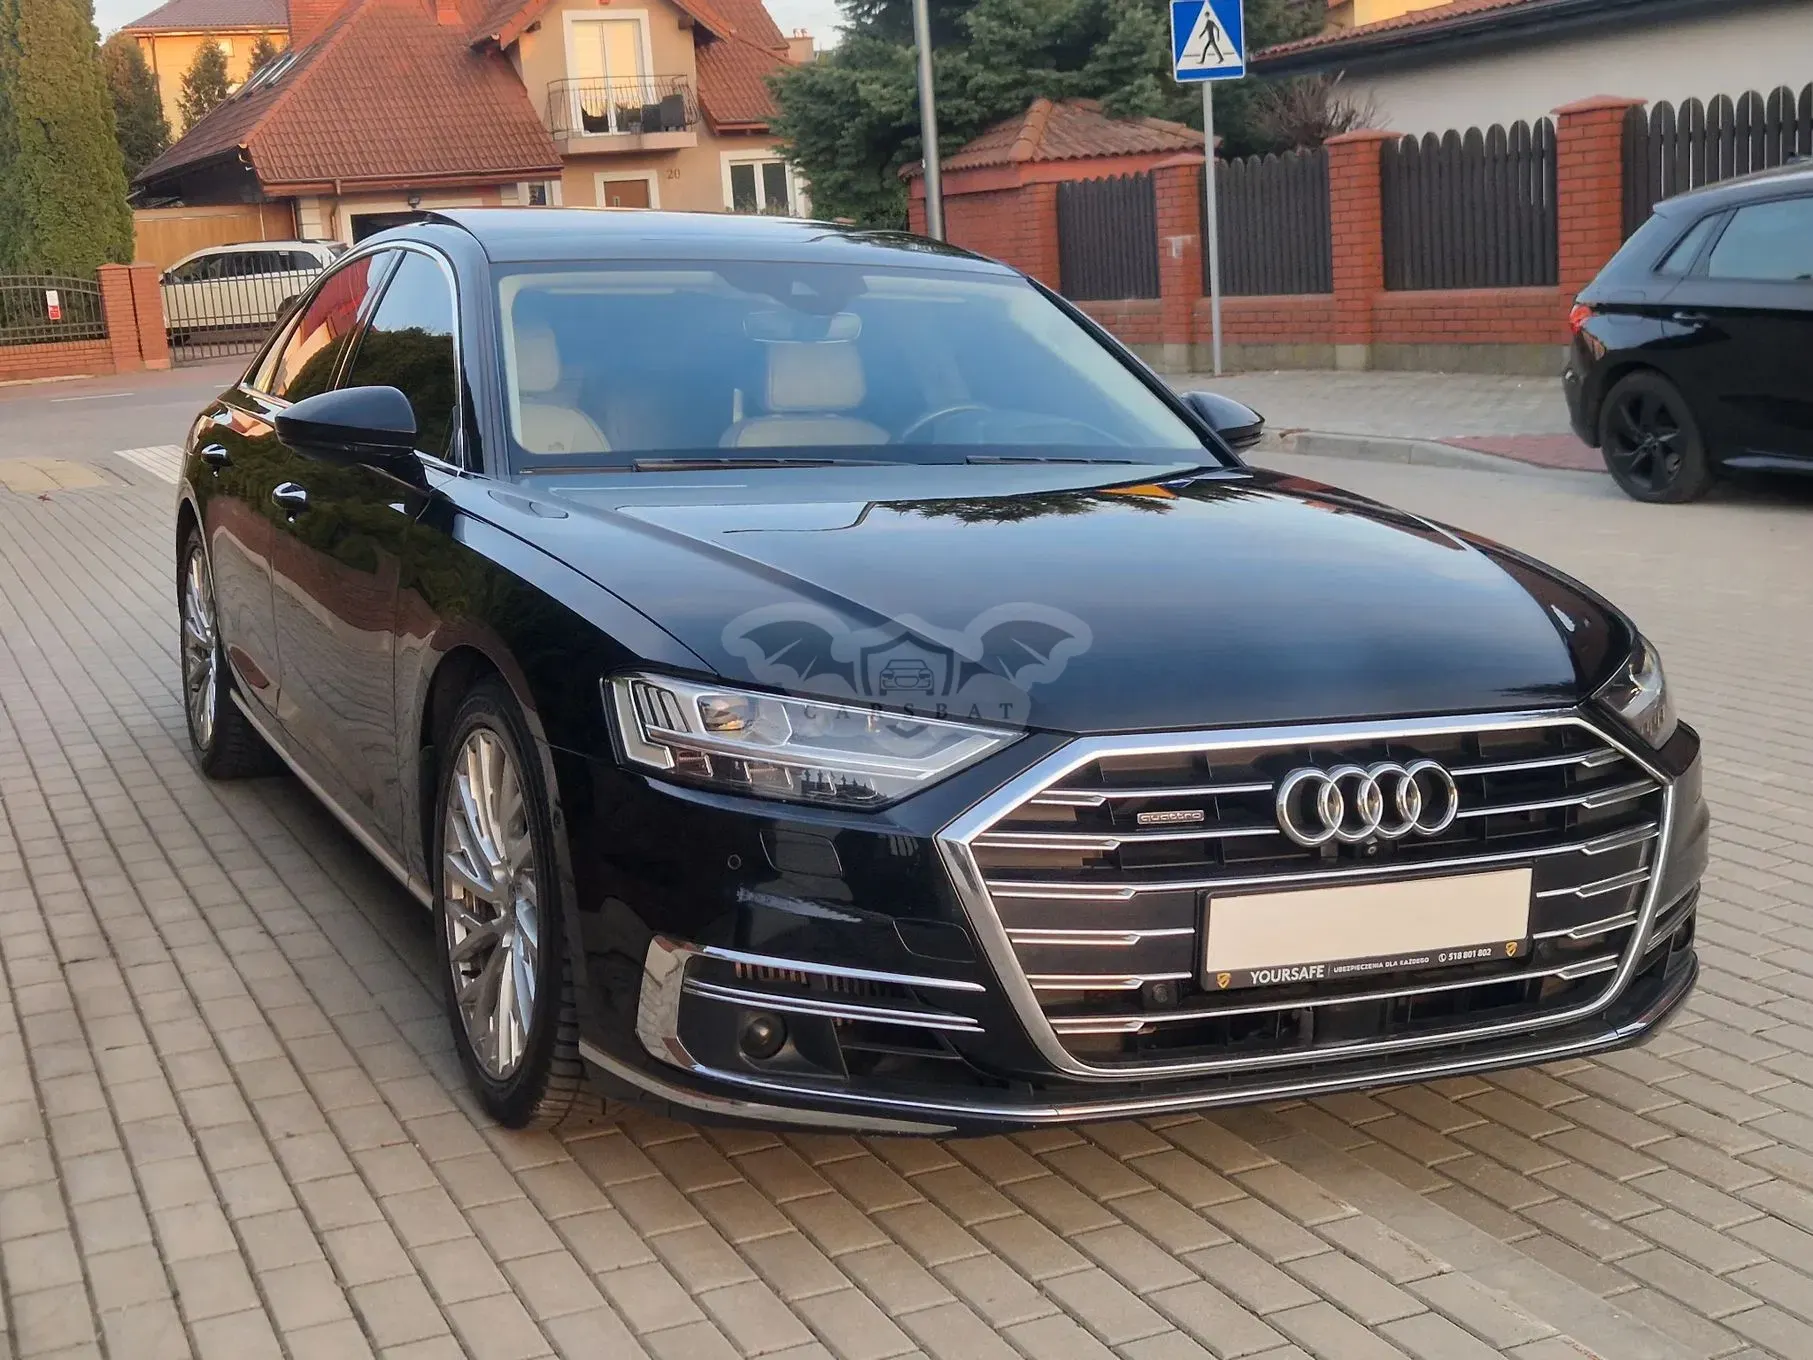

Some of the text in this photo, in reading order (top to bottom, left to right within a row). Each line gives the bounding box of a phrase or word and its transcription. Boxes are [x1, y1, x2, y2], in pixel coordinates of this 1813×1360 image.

[666, 168, 680, 180] 20
[1140, 812, 1202, 822] quattro
[1250, 964, 1325, 985] YOURSAFE
[1448, 952, 1462, 961] 518
[1463, 949, 1476, 959] 801
[1477, 948, 1492, 957] 802
